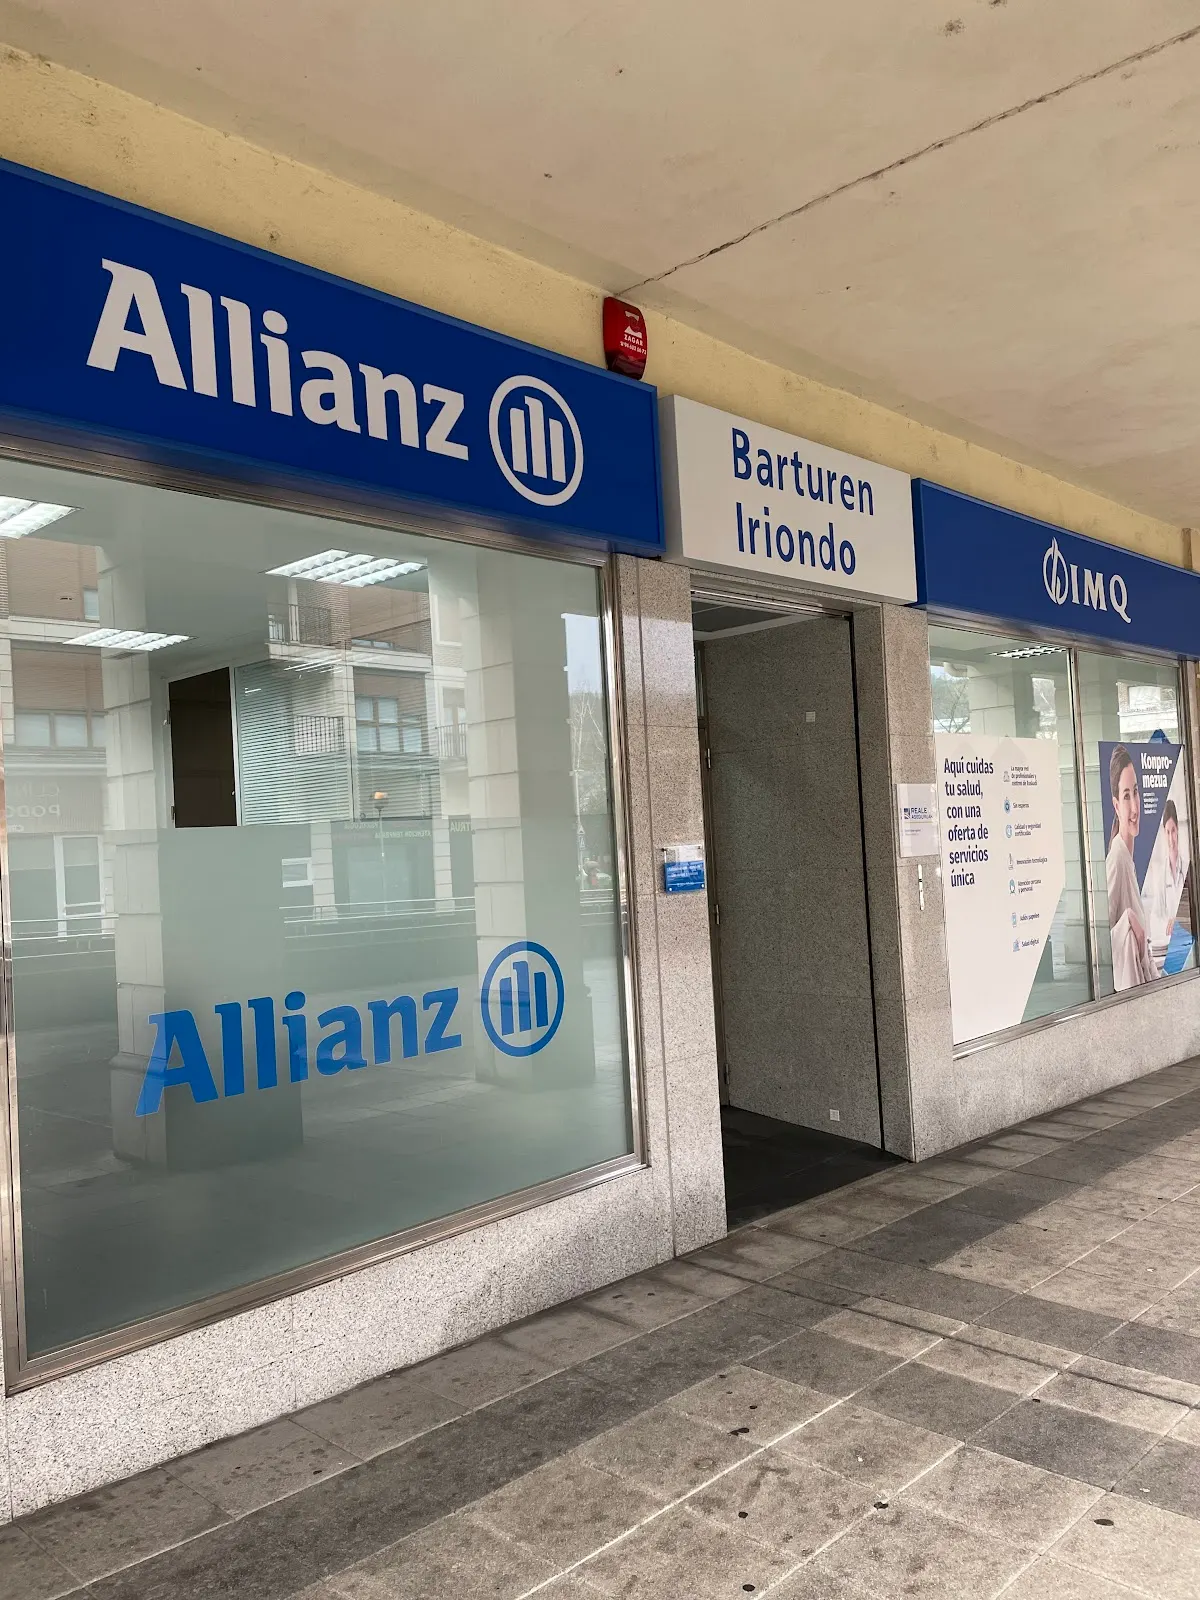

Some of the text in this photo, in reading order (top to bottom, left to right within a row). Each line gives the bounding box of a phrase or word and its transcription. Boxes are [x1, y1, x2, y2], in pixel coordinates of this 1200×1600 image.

[623, 333, 643, 346] ZAGAR
[86, 257, 469, 460] Allianz
[732, 427, 874, 516] Barturen
[736, 502, 856, 576] Iriondo
[1069, 563, 1132, 624] IMQ
[944, 756, 994, 778] Aquí cuidas
[1141, 753, 1172, 774] Konpro-
[945, 780, 983, 799] tu salud,
[1142, 774, 1168, 788] mezua
[947, 805, 981, 819] con una
[948, 824, 988, 841] oferta de
[949, 845, 988, 864] servicios
[951, 868, 975, 887] única
[135, 987, 462, 1117] Allianz
